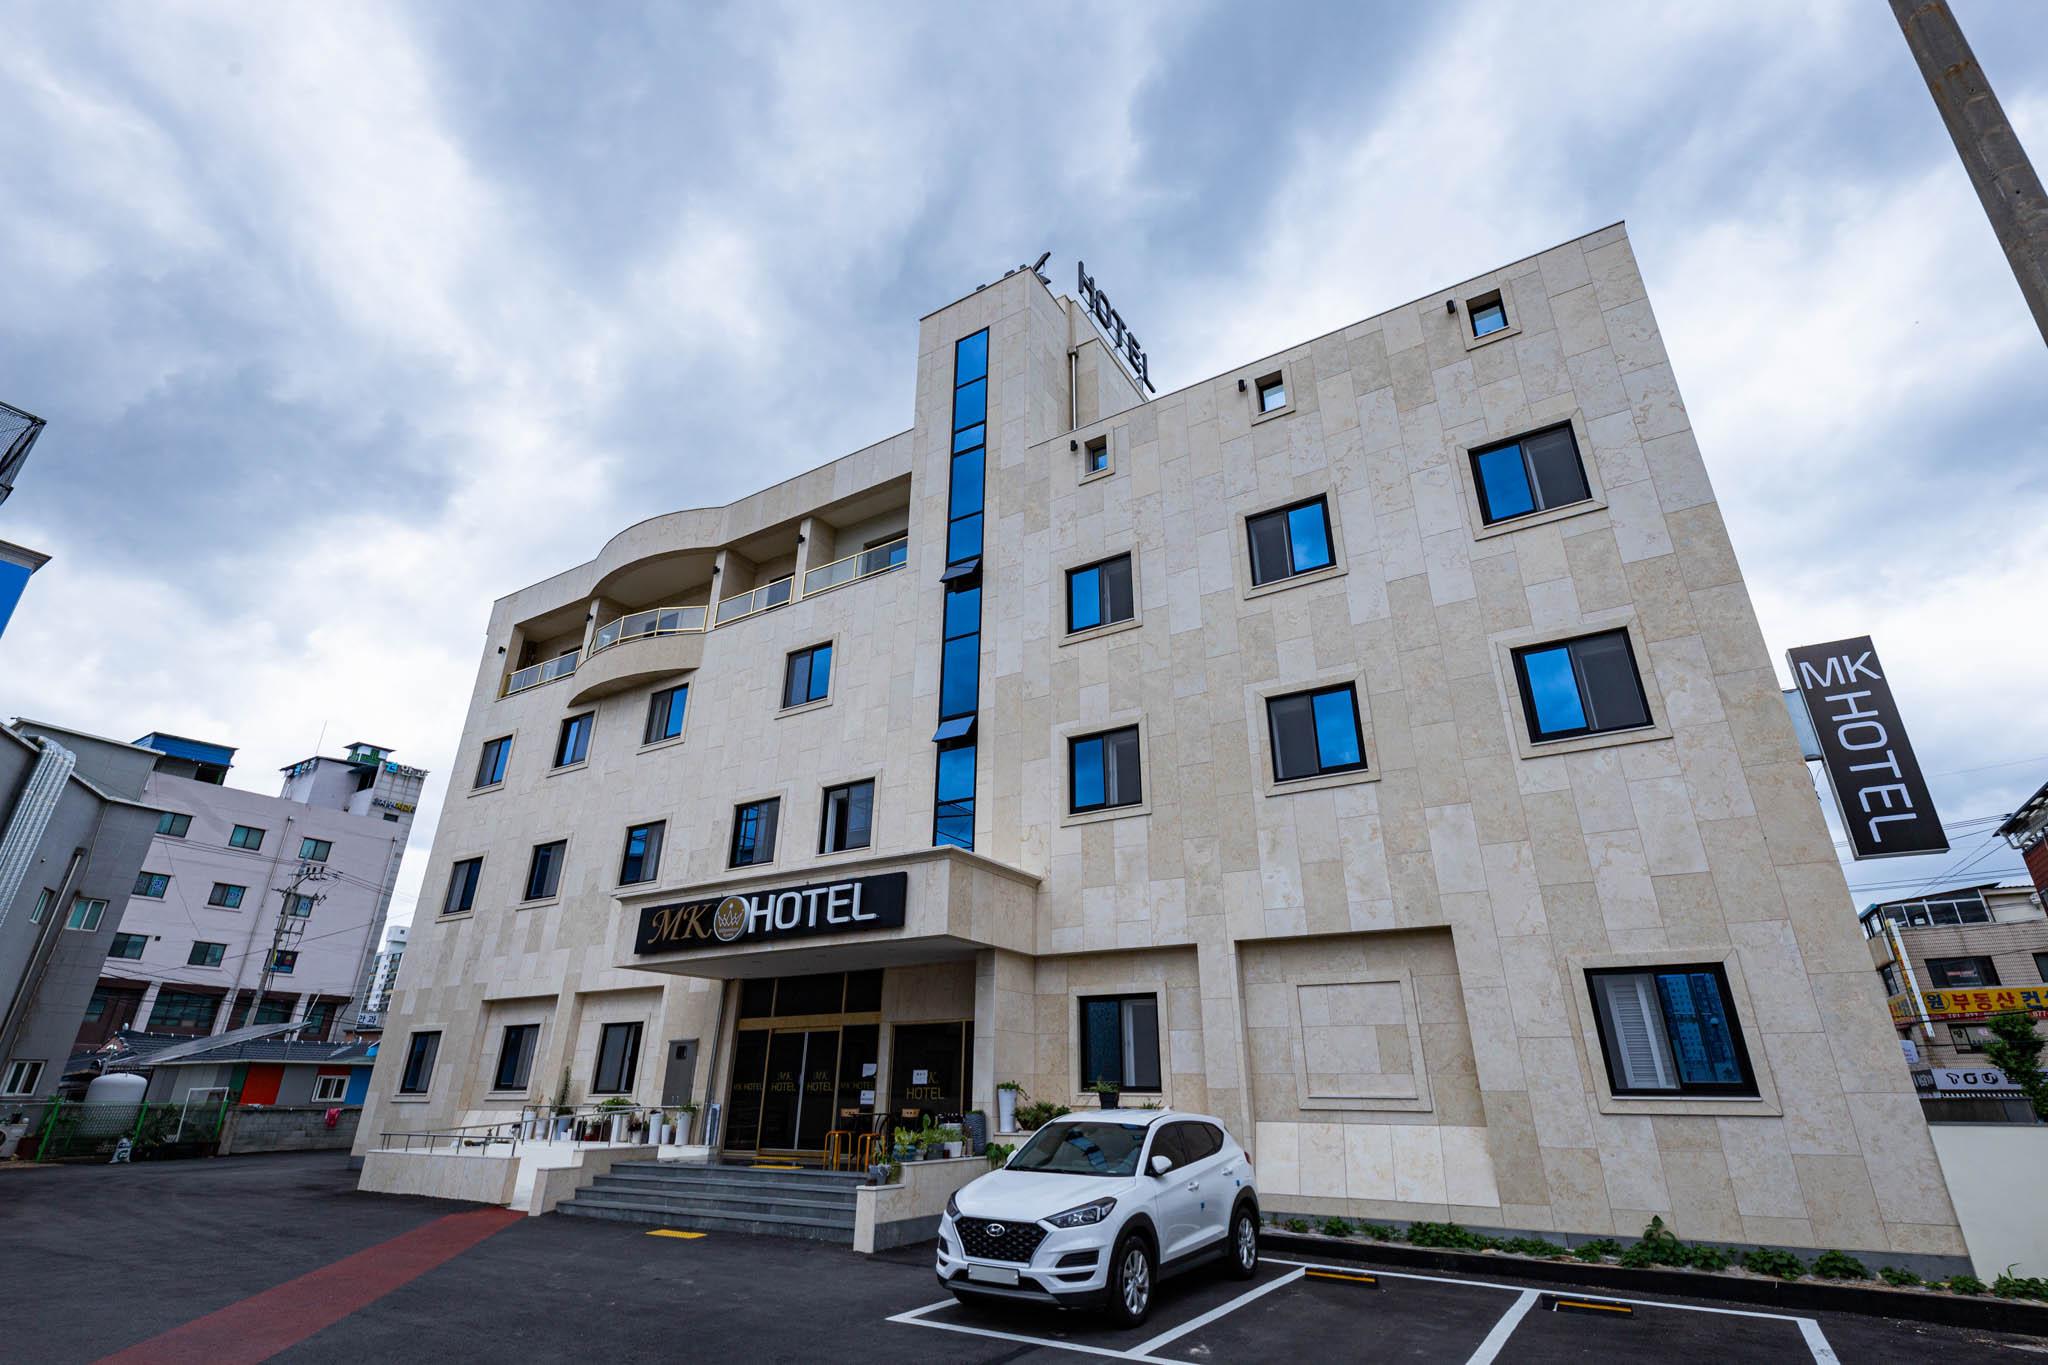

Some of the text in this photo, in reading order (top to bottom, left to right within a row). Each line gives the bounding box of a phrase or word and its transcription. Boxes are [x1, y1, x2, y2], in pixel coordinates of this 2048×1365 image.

[1078, 261, 1156, 394] HOTEL
[1799, 651, 1881, 690] MK
[1825, 690, 1917, 843] HOTEL
[648, 882, 878, 944] MK HOTEL
[1951, 991, 2016, 1010] 부동산
[2020, 990, 2048, 1009] 컨
[771, 1082, 796, 1092] HOTEL
[807, 1081, 833, 1091] HOTEL
[906, 1087, 945, 1101] HOTEL
